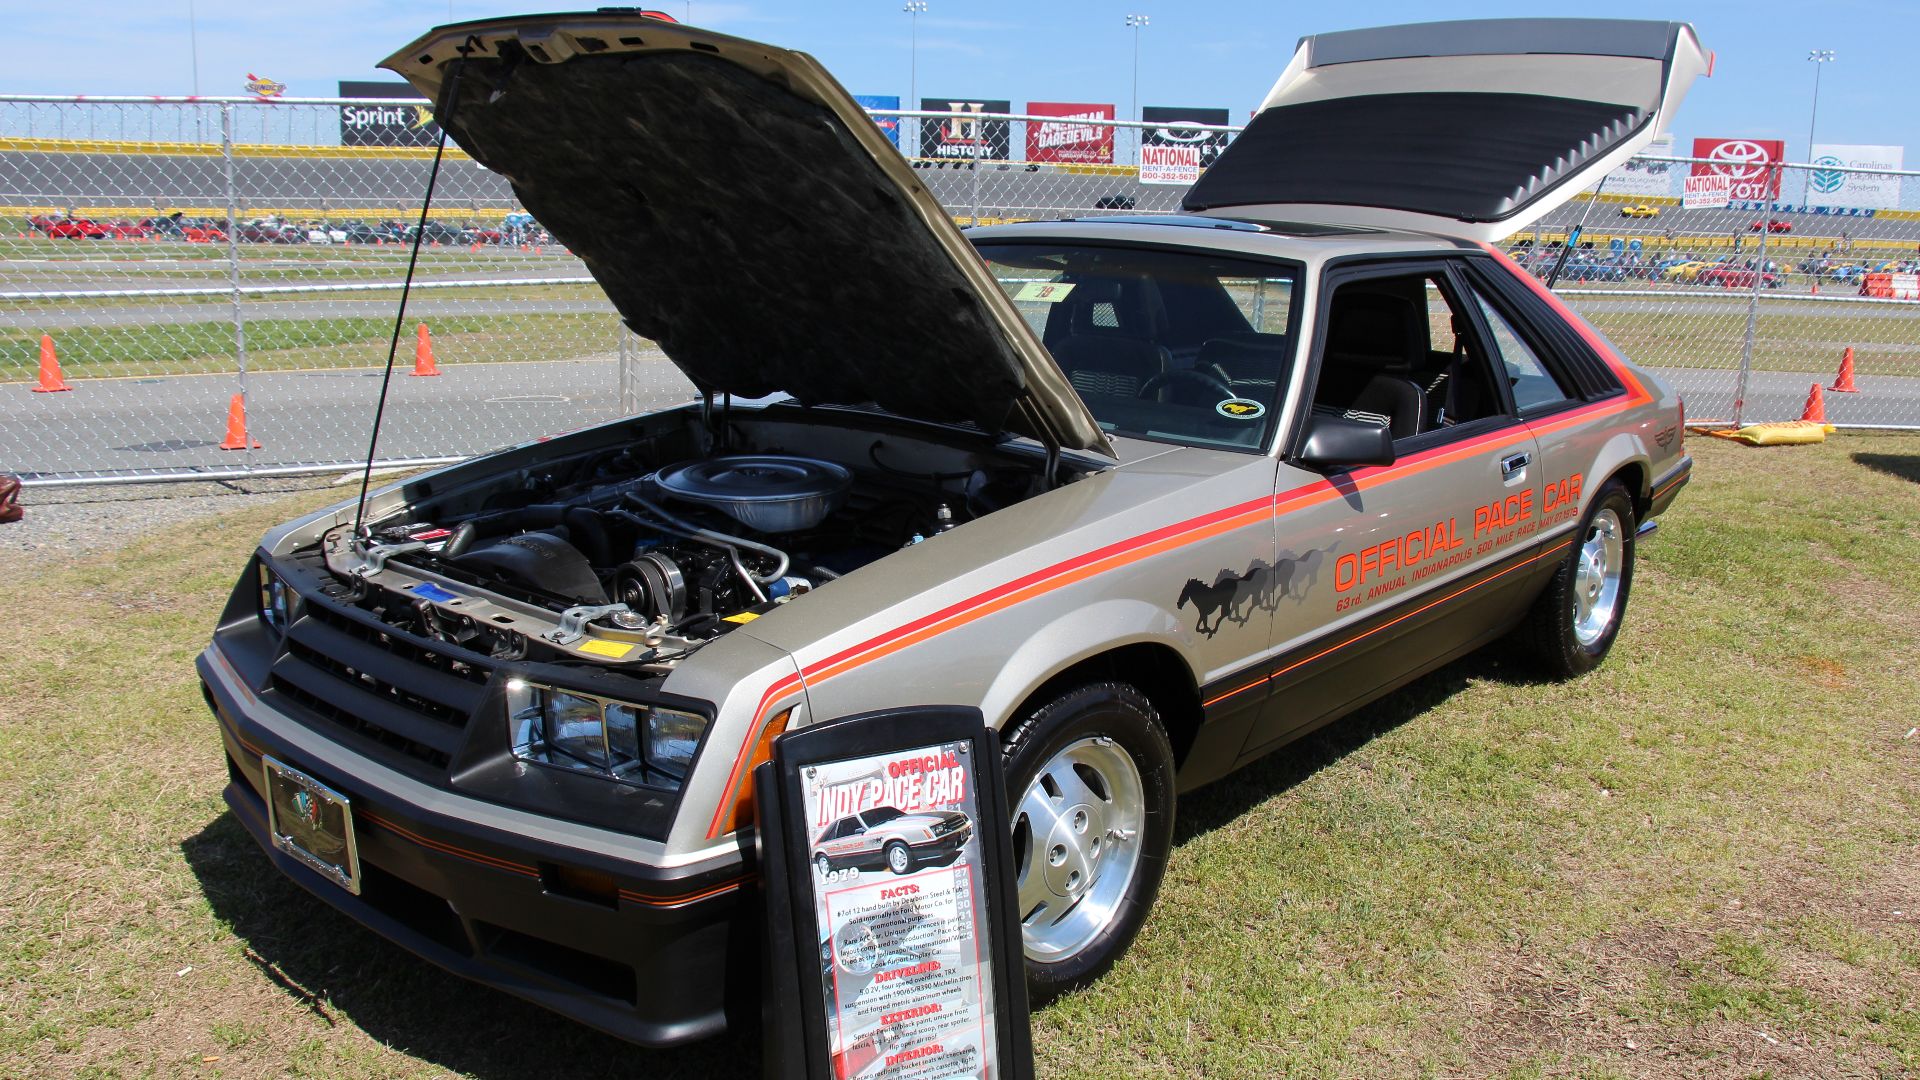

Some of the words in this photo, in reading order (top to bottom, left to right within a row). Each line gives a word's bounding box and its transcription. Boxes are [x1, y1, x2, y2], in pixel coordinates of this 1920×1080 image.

[246, 82, 287, 91] SUNOCO
[343, 105, 407, 129] Sprint
[1038, 127, 1104, 149] DAREDEVILS
[1142, 148, 1198, 167] NATIONAL
[1142, 166, 1198, 174] RENT-A-FENCE
[1142, 173, 1197, 181] 800-352-5675
[1685, 177, 1728, 193] NATIONAL
[1684, 191, 1728, 199] RENT-A-FENCE
[1684, 197, 1728, 206] 800-352-5675
[1334, 517, 1464, 593] OFFICIAL
[1474, 488, 1533, 540] PACE
[1543, 472, 1583, 513] CAR
[1367, 575, 1407, 600] ANNUAL
[1412, 547, 1473, 582] INDIANAPOLIS
[1476, 539, 1493, 556] 500
[1496, 530, 1515, 548] MILE
[1517, 521, 1537, 538] RACE
[888, 752, 960, 778] OFFICIAL
[814, 781, 867, 827] INDY
[869, 772, 924, 812] PACE
[924, 764, 967, 808] CAR
[819, 866, 861, 886] 1979
[861, 904, 877, 912] hand
[892, 900, 900, 908] by
[901, 895, 929, 905] Dearborn
[930, 889, 945, 899] Steel
[880, 884, 920, 900] FACTS:
[900, 905, 914, 914] Ford
[914, 902, 933, 911] Motor
[870, 917, 907, 931] promotional
[884, 928, 906, 938] Unique
[860, 940, 891, 952] compared
[909, 951, 931, 962] Display
[874, 960, 942, 984] DRIVELINE:
[895, 978, 913, 988] speed
[944, 967, 957, 976] TRX
[844, 997, 878, 1009] suspension
[878, 992, 892, 1001] with
[933, 977, 959, 988] Michelin
[857, 1008, 869, 1016] and
[870, 1002, 891, 1013] forged
[911, 992, 941, 1003] aluminum
[941, 986, 962, 996] wheels
[881, 1003, 943, 1025] EXTERIOR:
[853, 1029, 875, 1041] Special
[916, 1017, 933, 1027] paint,
[933, 1013, 954, 1021] unique
[954, 1008, 969, 1016] front
[900, 1039, 916, 1049] open
[885, 1044, 944, 1067] INTERIOR:
[901, 1061, 921, 1071] bucket
[921, 1057, 937, 1066] seats
[952, 1064, 977, 1076] wrapped
